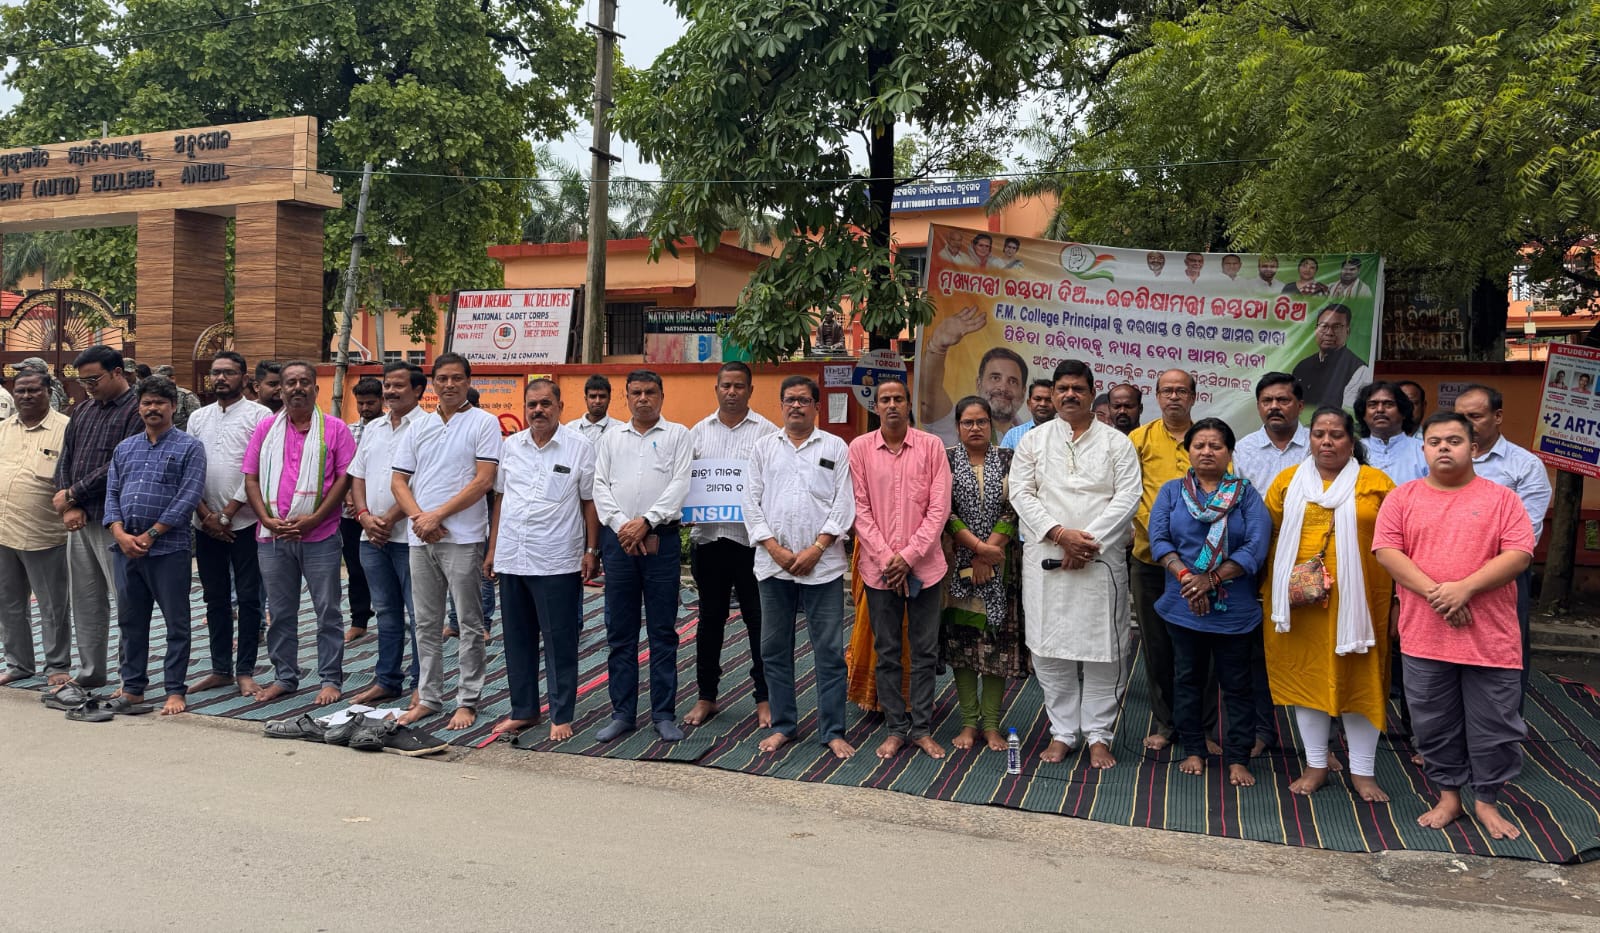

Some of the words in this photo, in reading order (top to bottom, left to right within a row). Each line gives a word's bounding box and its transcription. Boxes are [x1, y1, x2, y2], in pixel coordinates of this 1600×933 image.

[32, 176, 81, 198] (AUTO)
[181, 163, 230, 184] ANGUL
[458, 294, 483, 309] NATION
[484, 293, 512, 308] DREAMS
[536, 293, 571, 307] DELIVERS
[1273, 295, 1308, 322] ଦିଅ
[472, 312, 502, 321] NATIONAL
[505, 311, 526, 320] CADET
[529, 311, 549, 320] CORPS
[648, 311, 675, 323] NATION
[1019, 306, 1060, 326] College
[1062, 311, 1110, 332] Principal
[1557, 347, 1593, 358] STUDENT
[874, 360, 901, 369] TORQUE
[1543, 412, 1562, 428] +2
[706, 483, 732, 492] ଆମର
[692, 506, 740, 521] NSUI
